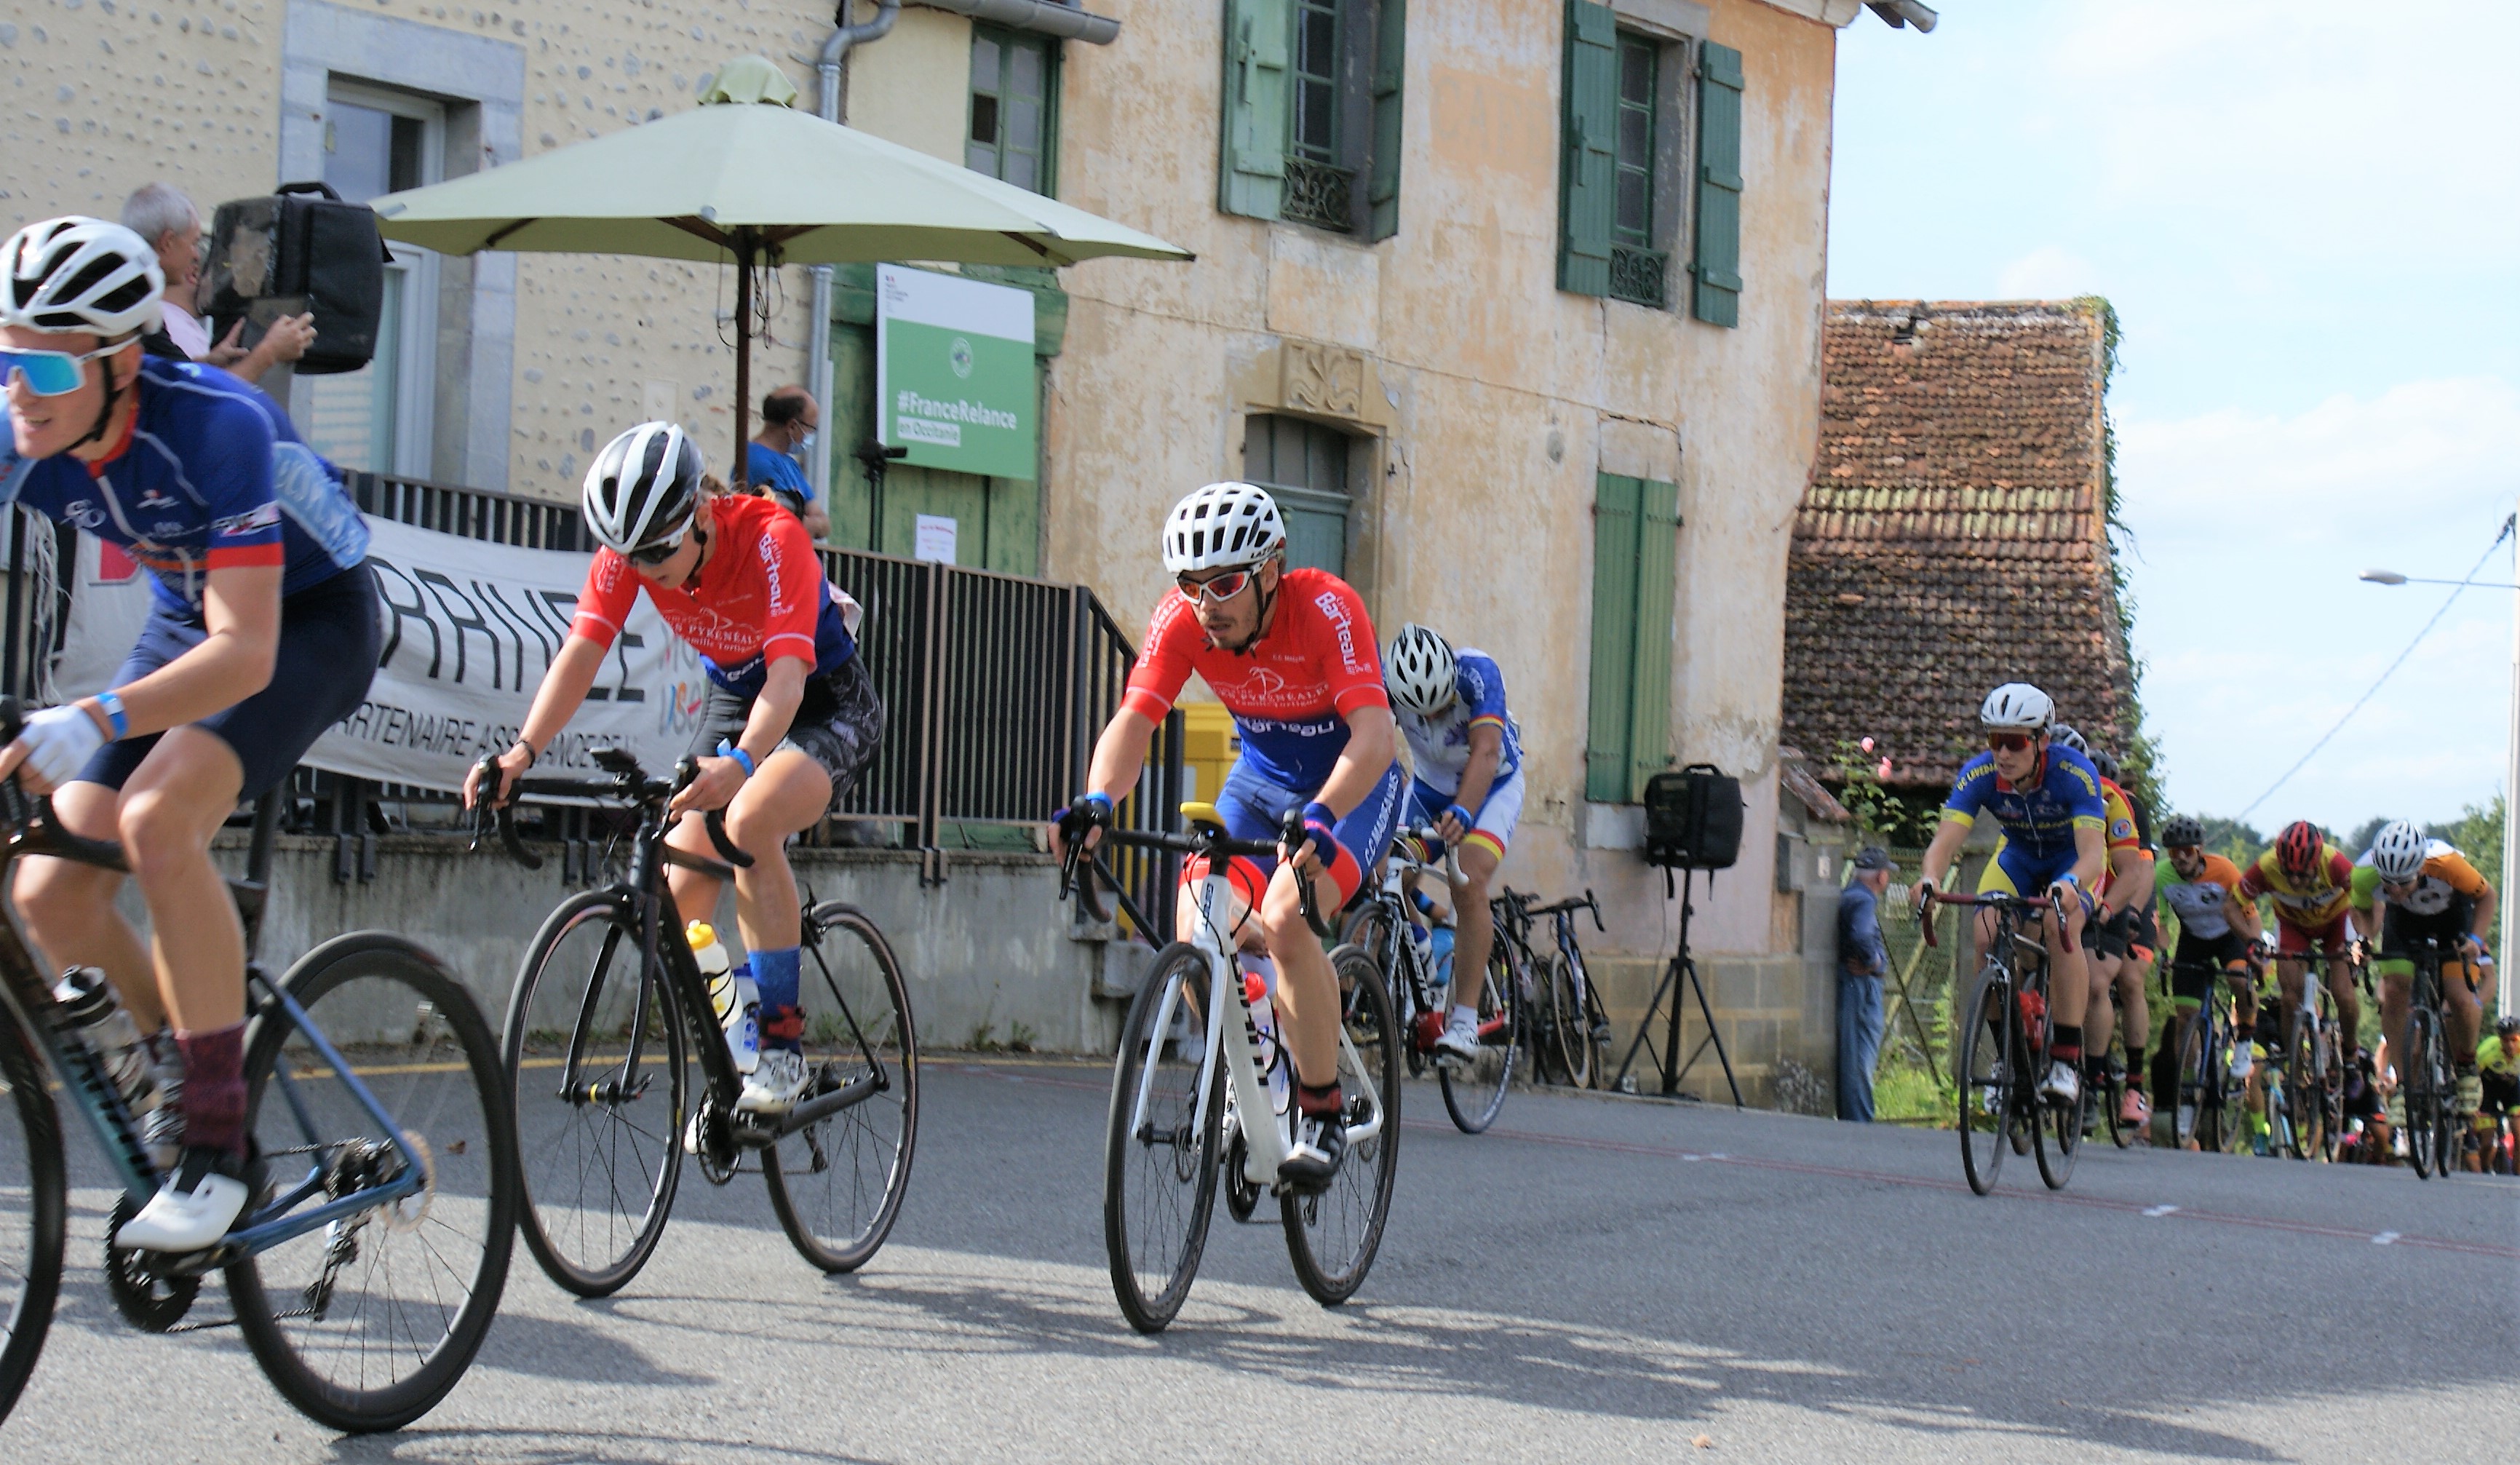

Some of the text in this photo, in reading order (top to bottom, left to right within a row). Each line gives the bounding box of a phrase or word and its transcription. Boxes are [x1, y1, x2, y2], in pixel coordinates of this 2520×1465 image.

[897, 390, 1017, 430] #FranceRelance
[913, 421, 958, 441] Occitanie
[366, 555, 646, 702] RRIVE
[1314, 591, 1356, 665] Barteau
[336, 702, 474, 757] ARTENAIRE
[471, 721, 597, 769] ASSANCE
